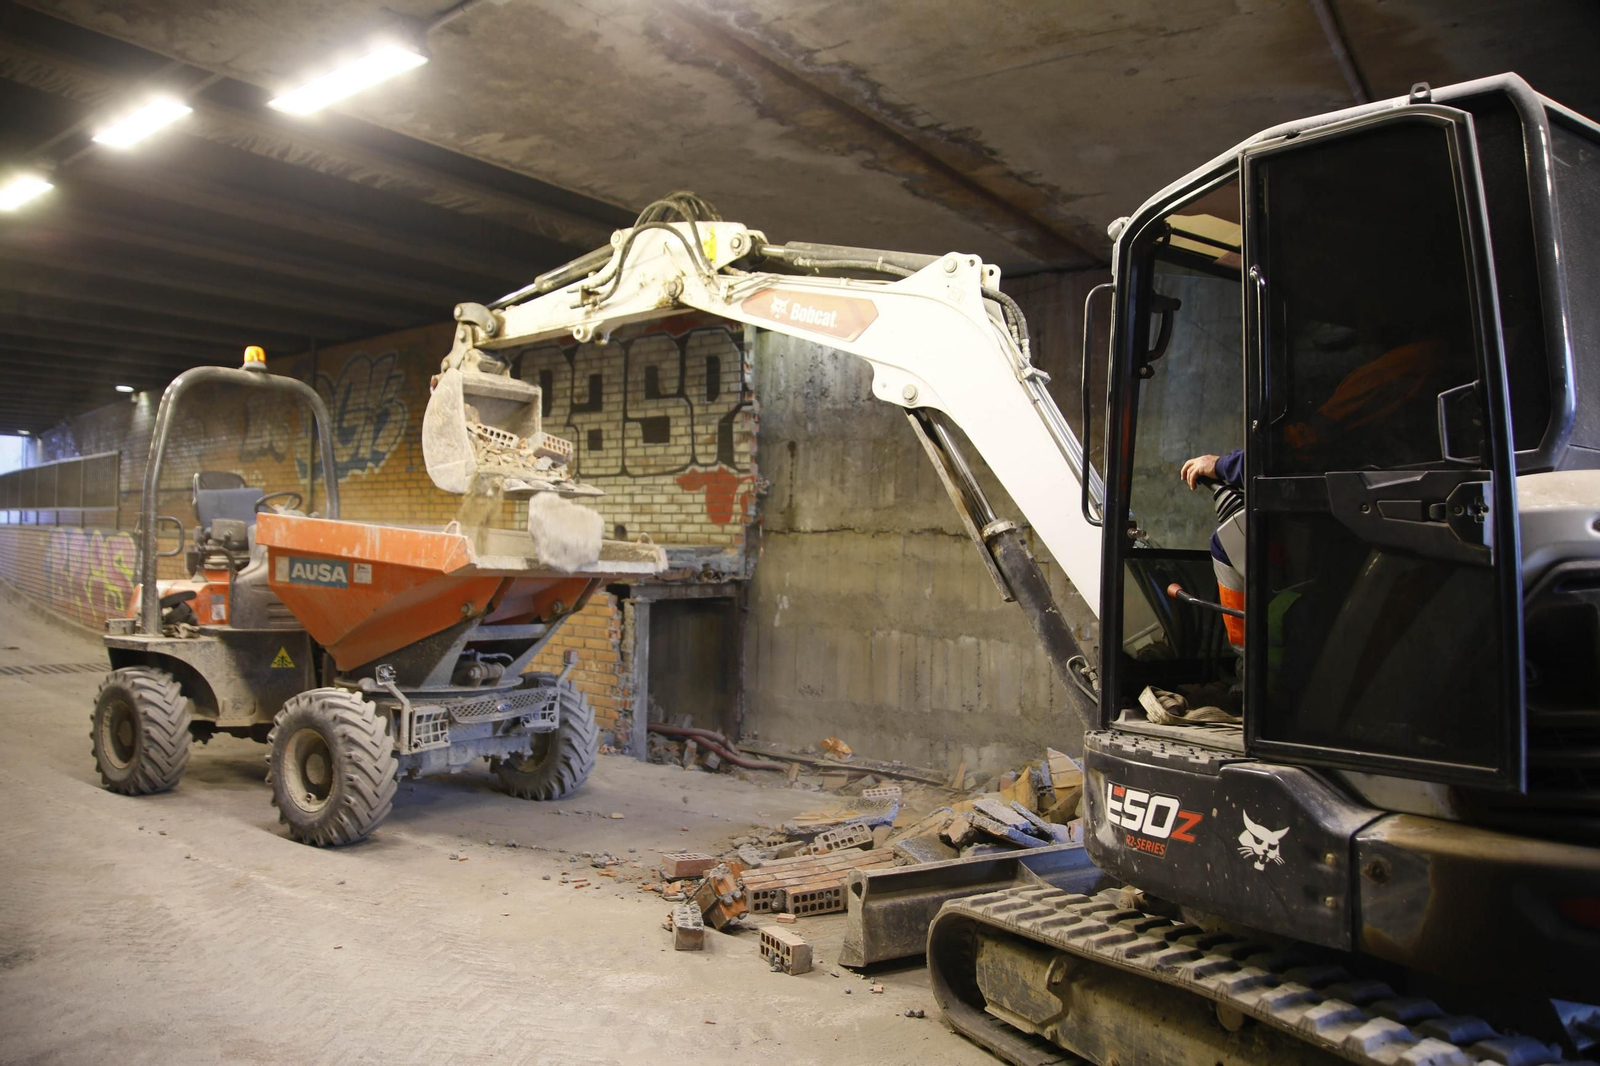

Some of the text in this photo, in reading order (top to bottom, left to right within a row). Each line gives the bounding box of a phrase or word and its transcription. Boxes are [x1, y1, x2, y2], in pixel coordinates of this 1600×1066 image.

[790, 303, 837, 328] Bobcat
[291, 563, 348, 583] AUSA
[1125, 834, 1166, 856] R2-SERIES
